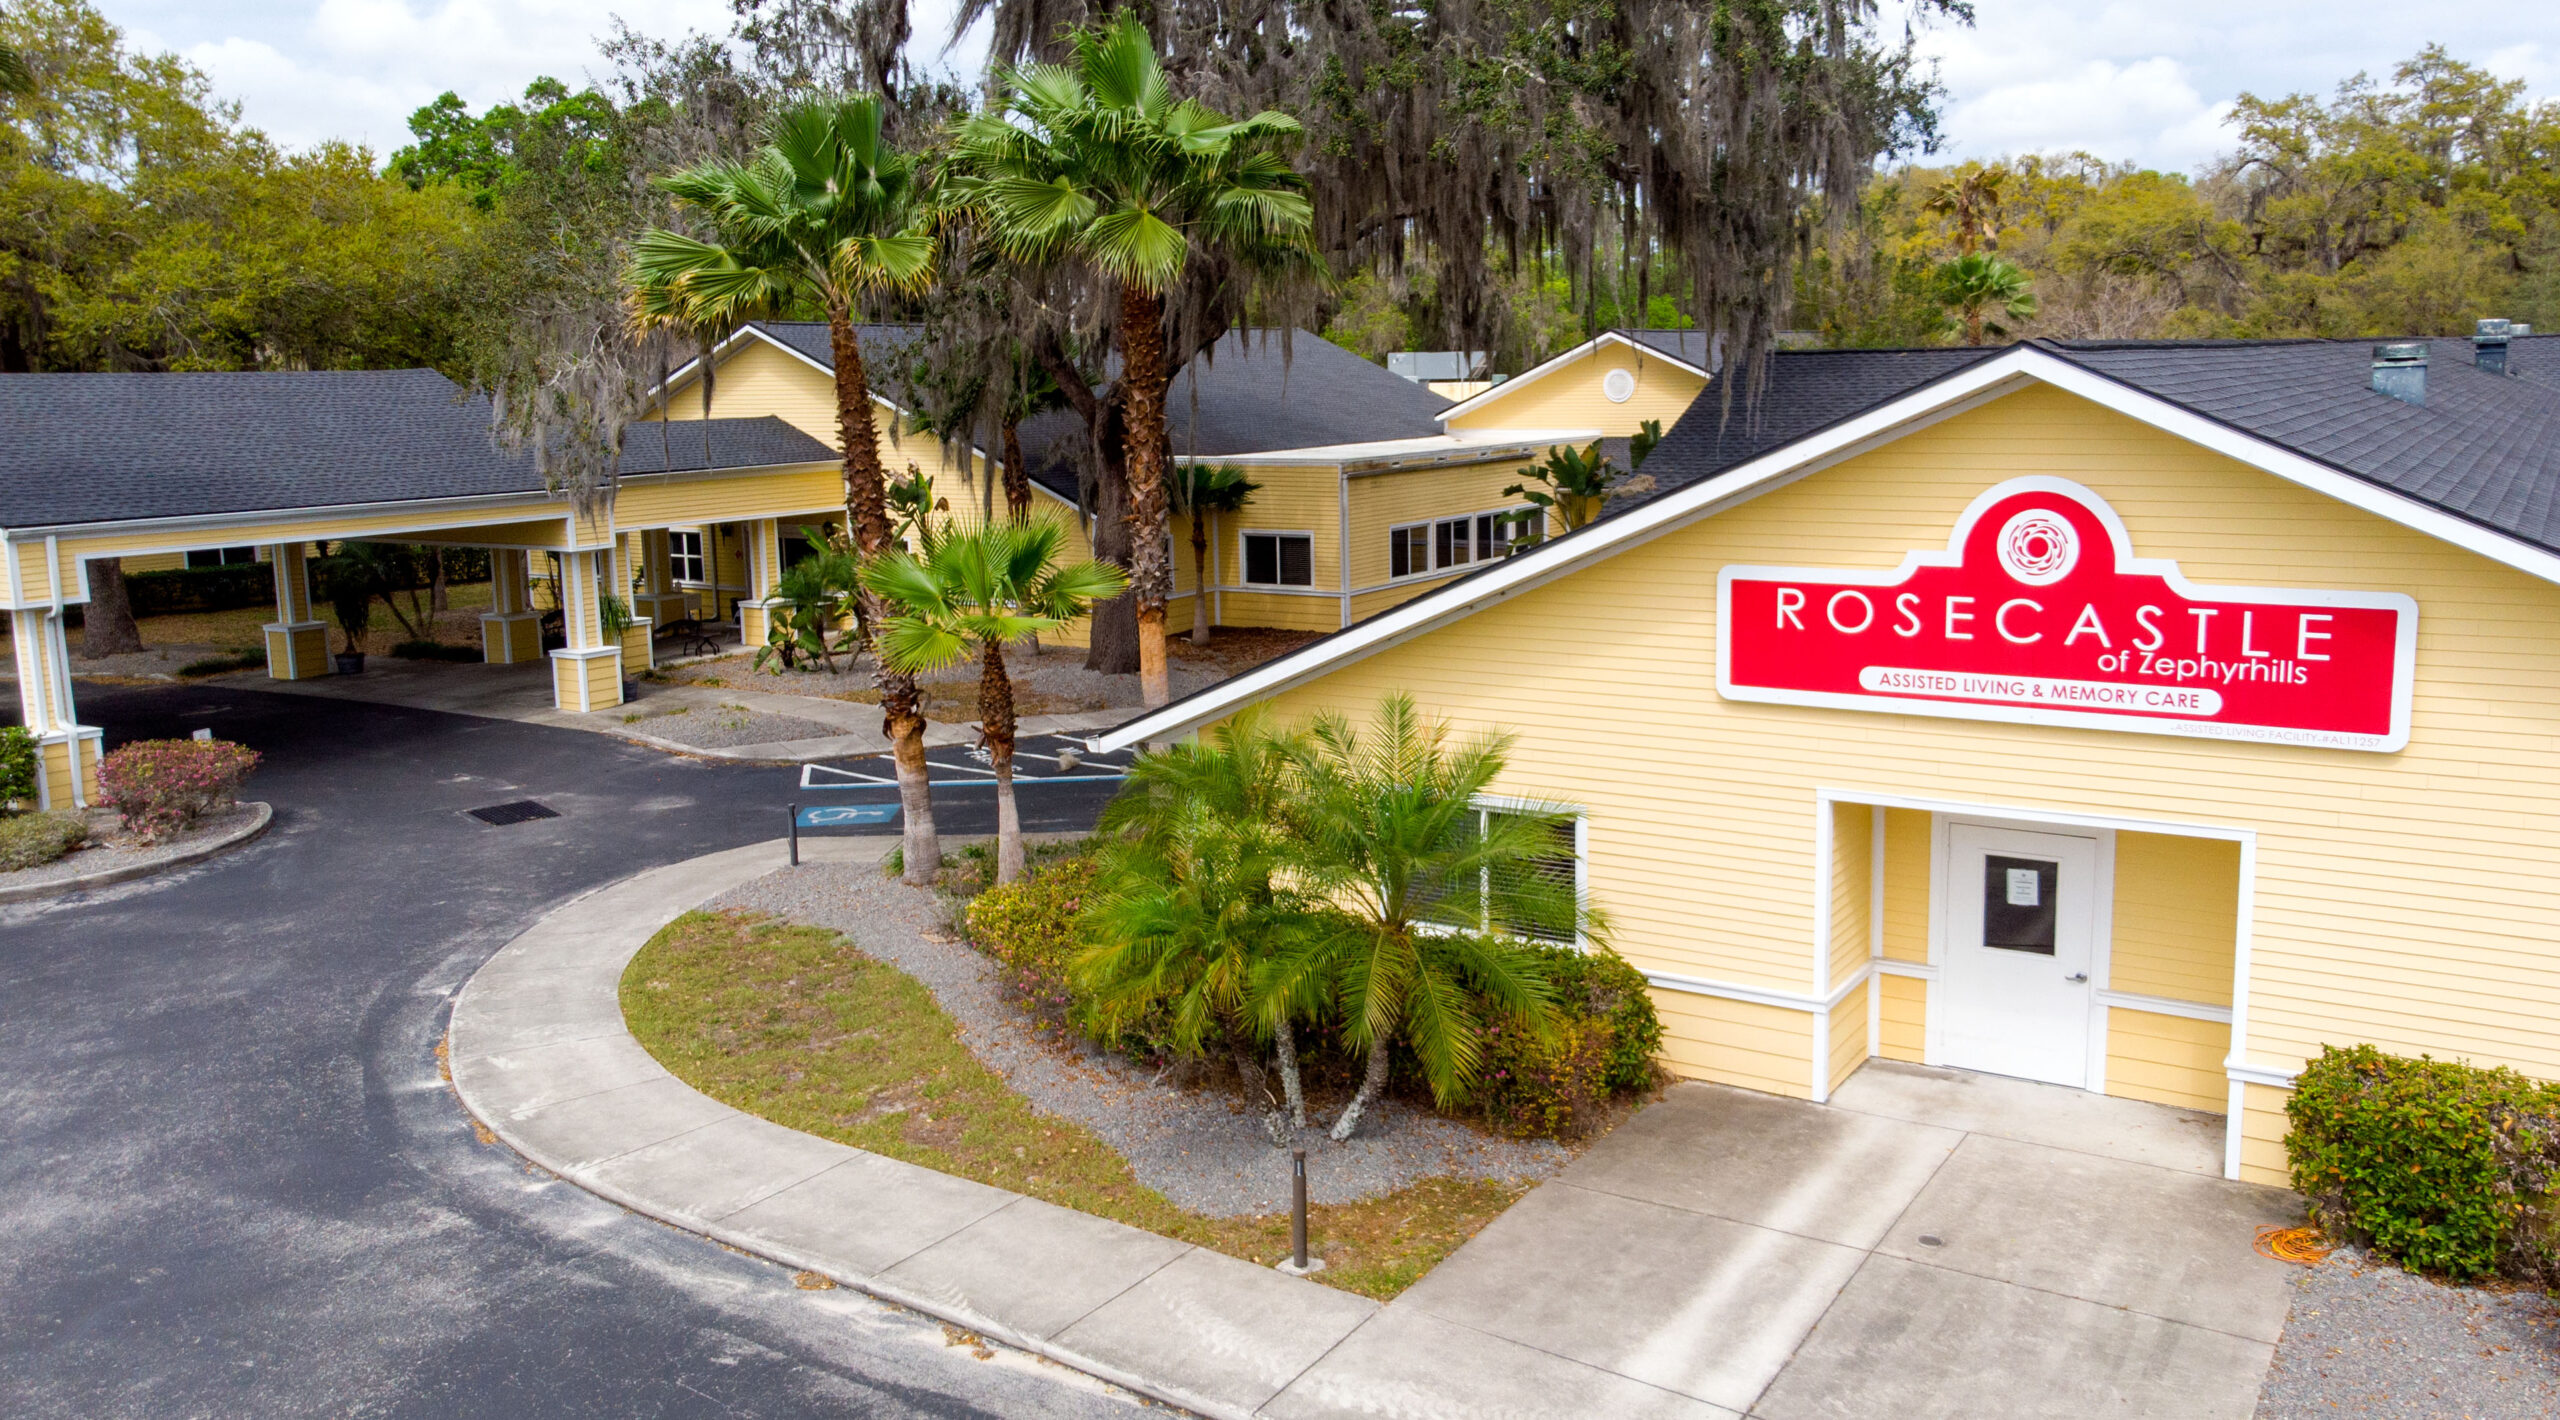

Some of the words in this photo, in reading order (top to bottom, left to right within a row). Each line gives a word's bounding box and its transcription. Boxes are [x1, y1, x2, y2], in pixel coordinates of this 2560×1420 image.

[1776, 587, 2333, 661] ROSECASTLE
[2097, 649, 2131, 673] of
[2138, 650, 2308, 685] Zephyrhills
[1879, 672, 1957, 691] ASSISTED
[1963, 678, 2026, 697] LIVING
[2031, 684, 2045, 698] &
[2050, 684, 2138, 705] MEMORY
[2145, 690, 2201, 710] CARE
[2226, 727, 2265, 739] LIVING
